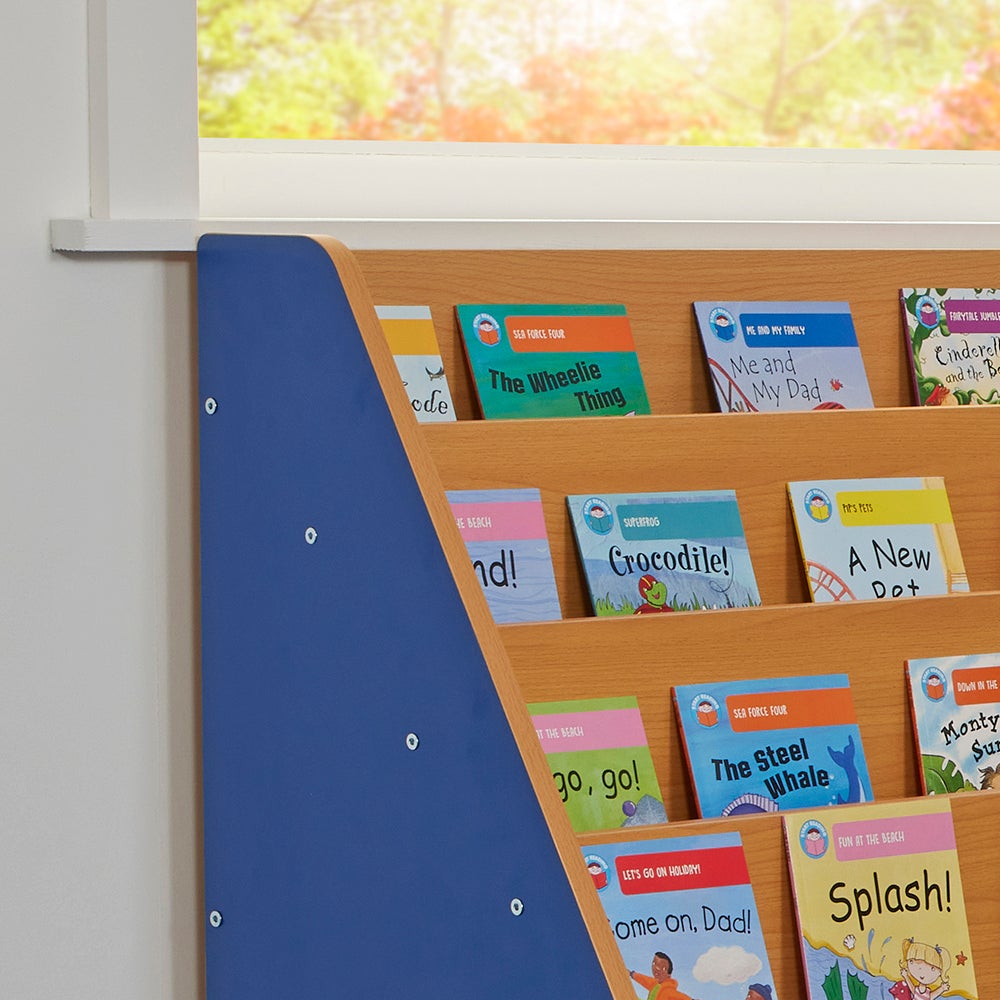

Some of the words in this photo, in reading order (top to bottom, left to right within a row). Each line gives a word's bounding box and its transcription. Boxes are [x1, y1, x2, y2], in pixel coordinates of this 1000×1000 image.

[950, 311, 979, 321] FAIRYTALE
[513, 329, 525, 339] SEA
[527, 329, 547, 339] FORCE
[548, 329, 566, 339] FOUR
[746, 326, 756, 335] ME
[757, 326, 770, 335] AND
[771, 326, 782, 335] MY
[784, 326, 805, 335] FAMILY
[730, 355, 760, 378] Me
[763, 351, 796, 375] and
[945, 366, 966, 384] and
[967, 366, 984, 381] the
[489, 368, 524, 393] The
[526, 361, 602, 394] Wheelie
[411, 389, 448, 414] ode
[574, 387, 627, 412] Thing
[752, 380, 780, 407] My
[786, 378, 822, 402] Dad
[859, 503, 873, 513] PETS
[466, 517, 492, 528] BEACH
[624, 517, 660, 528] SUPERFROG
[473, 549, 517, 589] nd!
[609, 544, 729, 576] Crocodile!
[849, 546, 867, 576] A
[872, 538, 931, 571] New
[957, 682, 976, 692] DOWN
[978, 681, 985, 690] IN
[986, 680, 998, 690] THE
[733, 708, 746, 719] SEA
[748, 706, 769, 718] FORCE
[770, 704, 787, 716] FOUR
[545, 728, 560, 739] THE
[560, 726, 584, 737] BEACH
[711, 758, 752, 782] The
[753, 738, 809, 771] Steel
[602, 760, 640, 799] go!
[764, 766, 830, 800] Whale
[838, 837, 853, 848] FUN
[855, 836, 863, 846] AT
[866, 833, 880, 845] THE
[881, 831, 905, 844] BEACH
[622, 869, 641, 881] LET'S
[643, 868, 654, 879] GO
[657, 867, 668, 878] ON
[669, 864, 702, 877] HOLIDAY!
[829, 869, 951, 931] Splash!
[606, 917, 660, 940] ome
[665, 913, 698, 934] on,
[702, 905, 752, 935] Dad!
